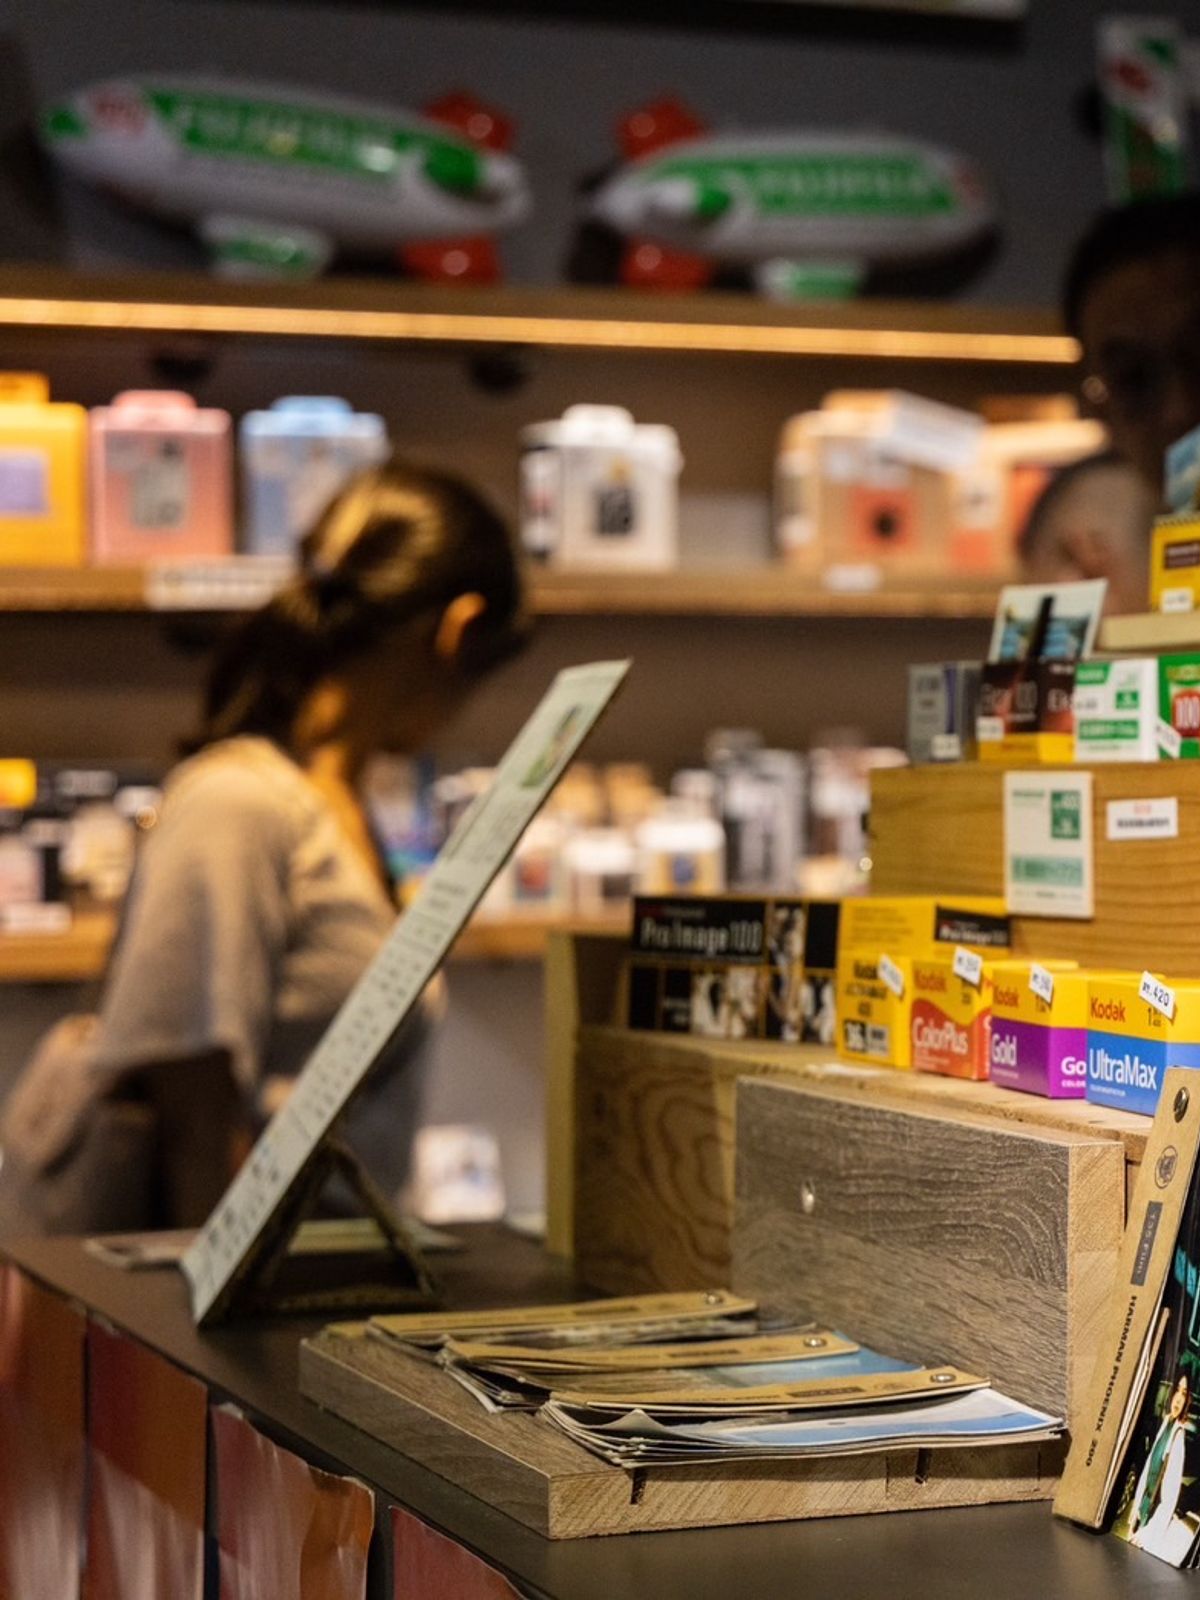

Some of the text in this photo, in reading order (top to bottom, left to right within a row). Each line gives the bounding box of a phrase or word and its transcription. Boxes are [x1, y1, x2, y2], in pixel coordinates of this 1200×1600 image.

[640, 918, 763, 955] Pro Image 100
[1090, 997, 1126, 1023] Kodak
[911, 1016, 968, 1055] ColorPlus
[991, 1033, 1017, 1066] Gold
[1089, 1047, 1158, 1091] UltraMax
[1085, 1295, 1138, 1467] HARMAN PHOENIX 200
